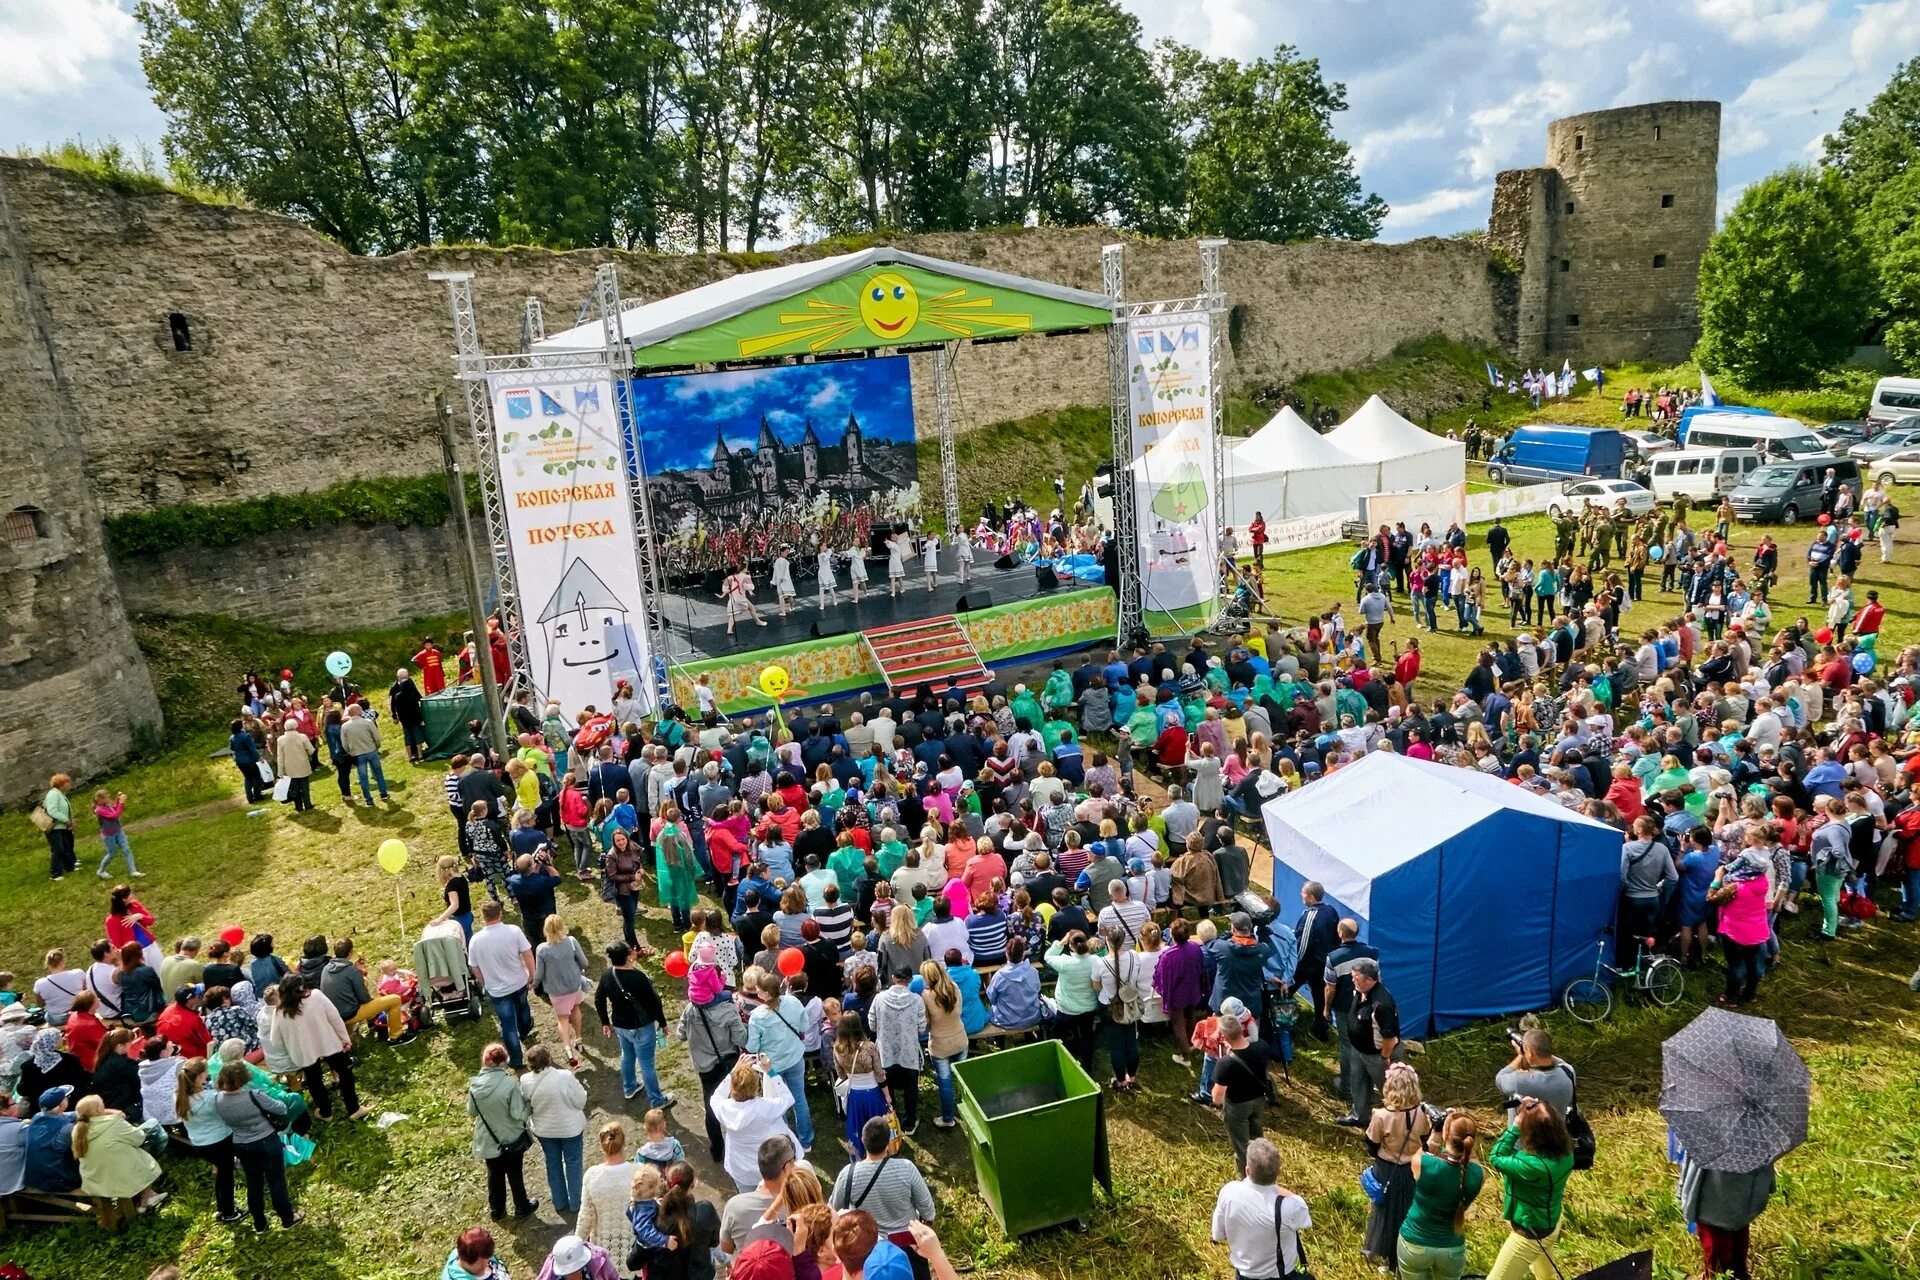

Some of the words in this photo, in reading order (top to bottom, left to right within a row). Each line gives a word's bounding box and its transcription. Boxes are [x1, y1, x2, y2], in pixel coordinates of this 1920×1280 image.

[1138, 406, 1204, 427] КОПОРСКАЯ
[515, 482, 616, 508] КОПОРСКАЯ
[528, 519, 616, 545] ПОТЕХА
